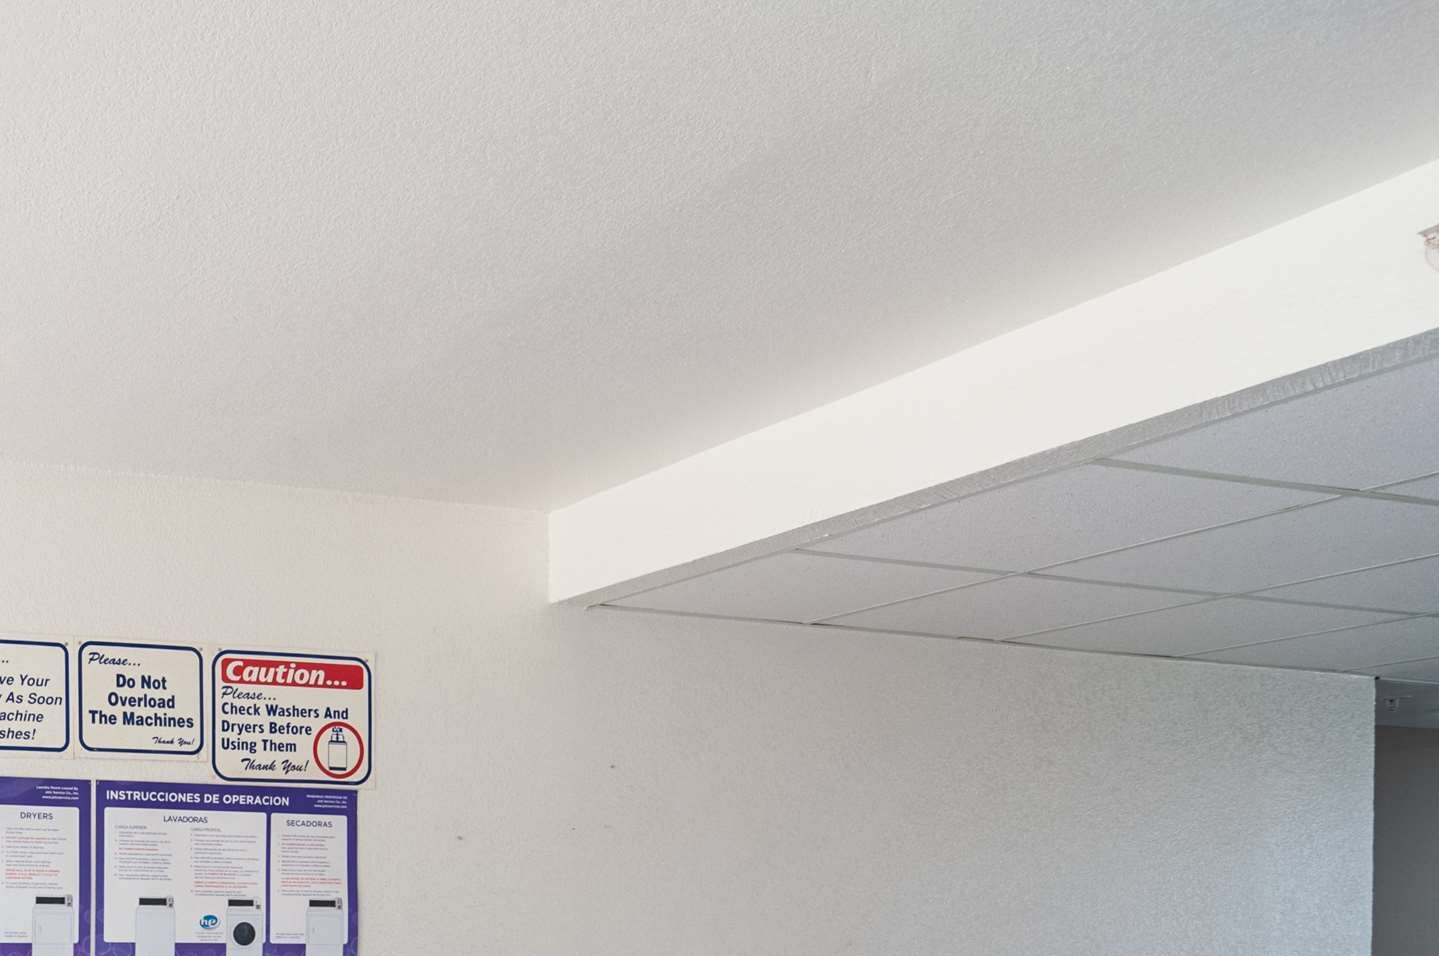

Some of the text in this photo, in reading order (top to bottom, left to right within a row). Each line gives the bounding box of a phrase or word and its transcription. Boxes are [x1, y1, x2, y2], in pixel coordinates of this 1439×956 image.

[88, 652, 141, 667] Please...
[20, 673, 50, 687] Your
[225, 660, 347, 687] Caution...
[116, 673, 167, 691] Do Not
[6, 691, 26, 704] As
[30, 692, 63, 706] Soon
[108, 692, 175, 709] Overload
[221, 687, 276, 701] Please...
[89, 710, 194, 728] The Machines
[222, 702, 349, 720] Check Washers And
[222, 720, 312, 738] Dryers Before
[152, 736, 195, 747] Thank You!
[222, 738, 297, 755] Using Them
[241, 758, 309, 774] Thank You!
[106, 790, 290, 806] INSTRUCCIONES DE OPERACION
[20, 812, 53, 820] DRYERS
[163, 816, 208, 824] LAVADORAS
[286, 820, 332, 828] SECADORAS
